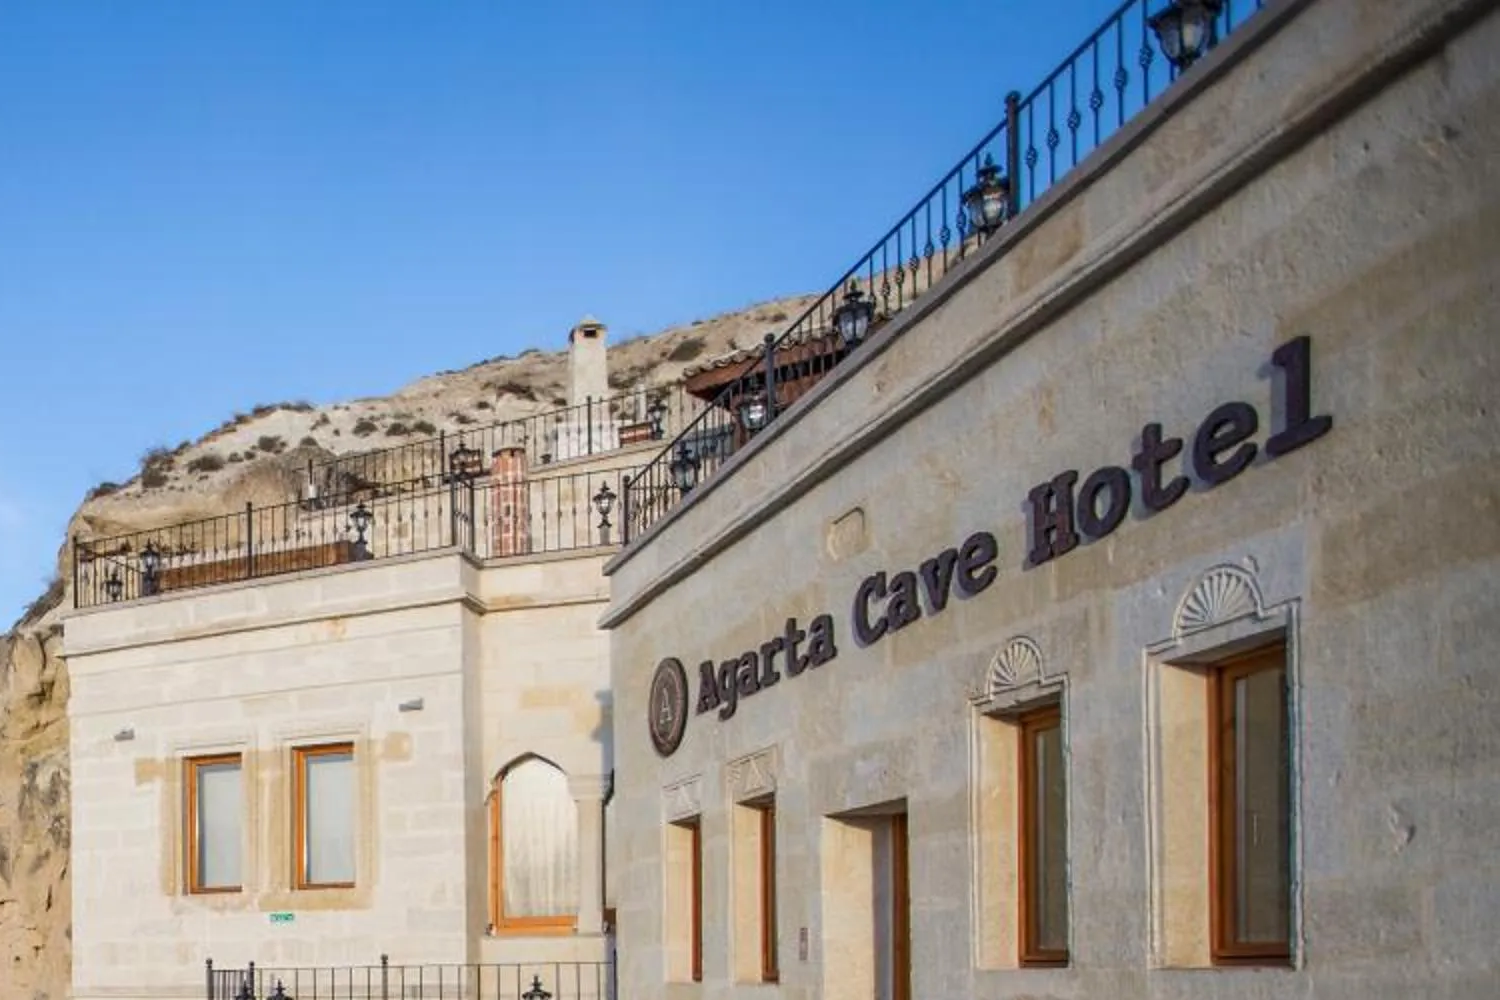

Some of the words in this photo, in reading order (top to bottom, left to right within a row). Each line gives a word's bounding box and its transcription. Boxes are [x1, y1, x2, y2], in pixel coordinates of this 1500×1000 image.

[697, 612, 838, 720] Agarta
[856, 530, 998, 643] Cave
[1026, 336, 1333, 565] Hotel
